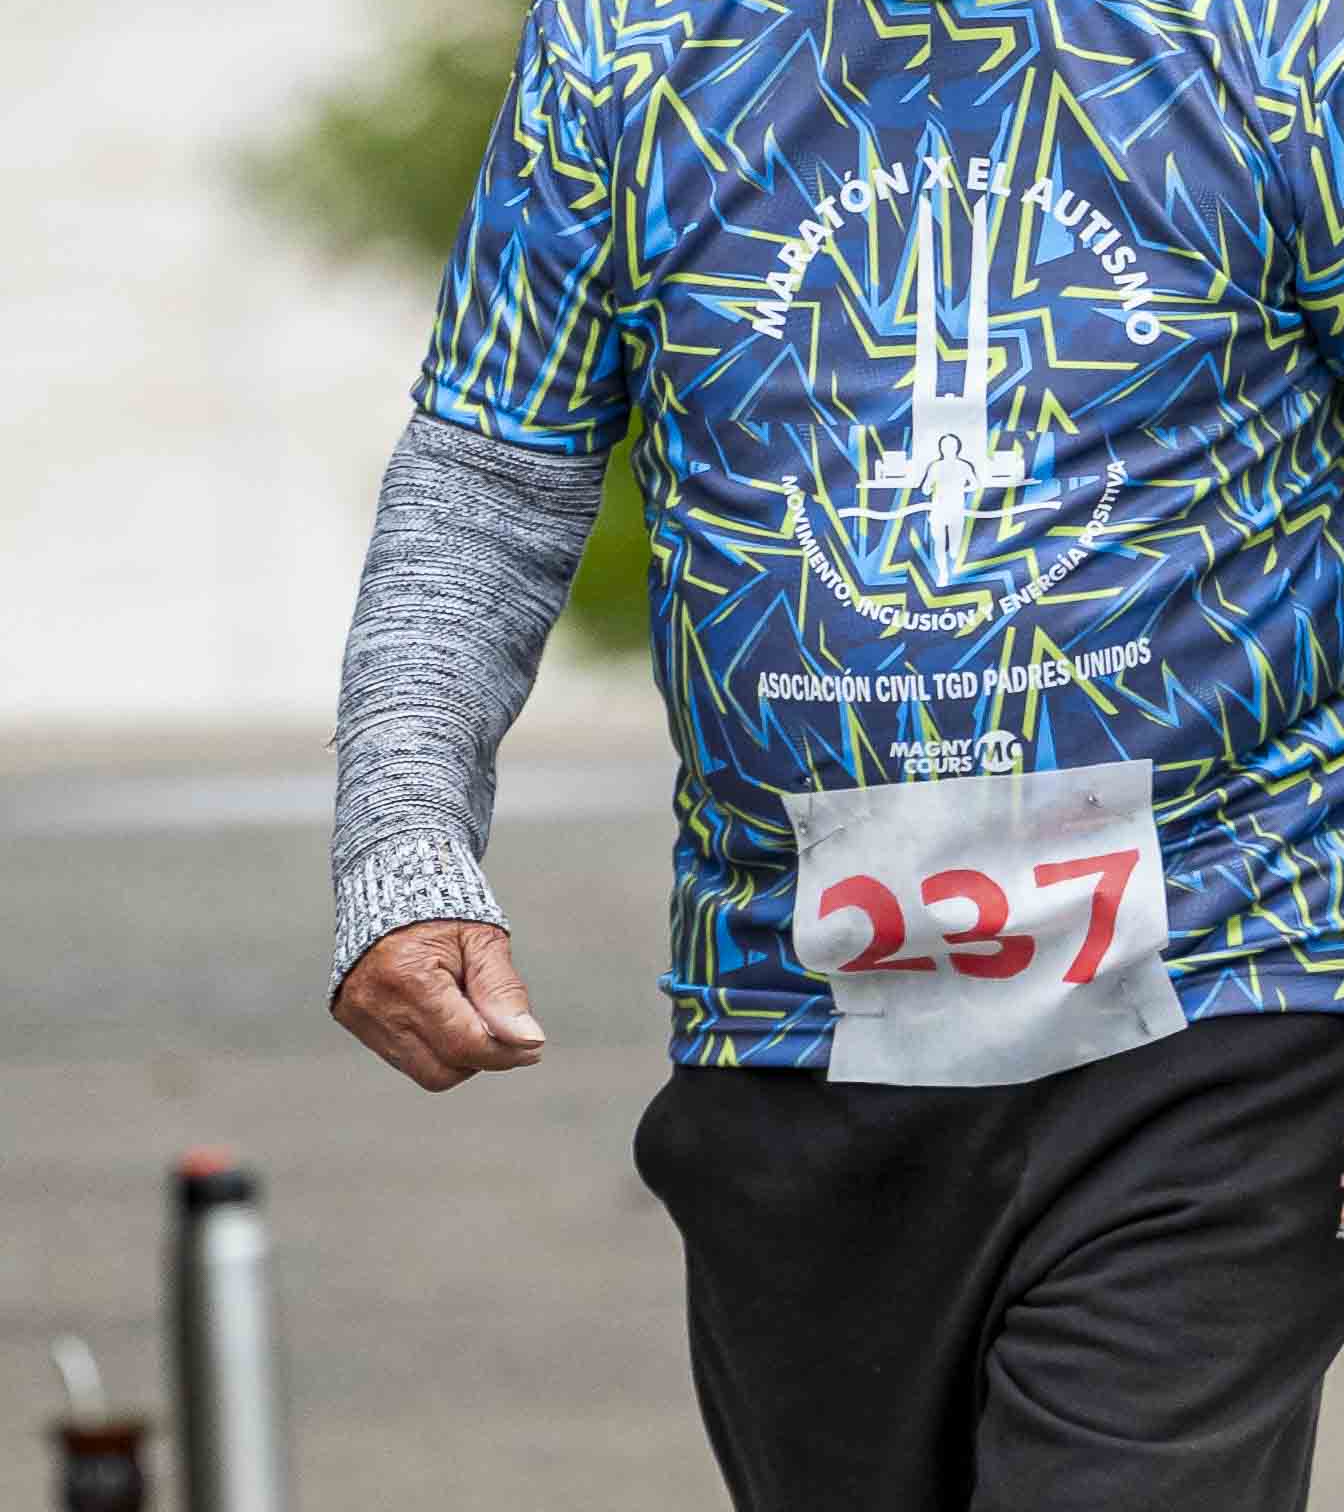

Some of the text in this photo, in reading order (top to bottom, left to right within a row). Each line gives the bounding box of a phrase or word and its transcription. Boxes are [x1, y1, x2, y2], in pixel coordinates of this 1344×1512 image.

[751, 155, 1162, 345] MARATÓN X EL AUTISMO
[856, 597, 975, 632] INCLUSIÓN
[999, 548, 1088, 615] ENERGÍA
[1078, 460, 1128, 548] POSITIVA
[758, 637, 1152, 703] ASOCIACIÓN CIVIL TGD PADRES UNIDOS
[889, 739, 972, 757] MAGNY
[903, 756, 973, 774] COURS
[818, 848, 1140, 984] 237
